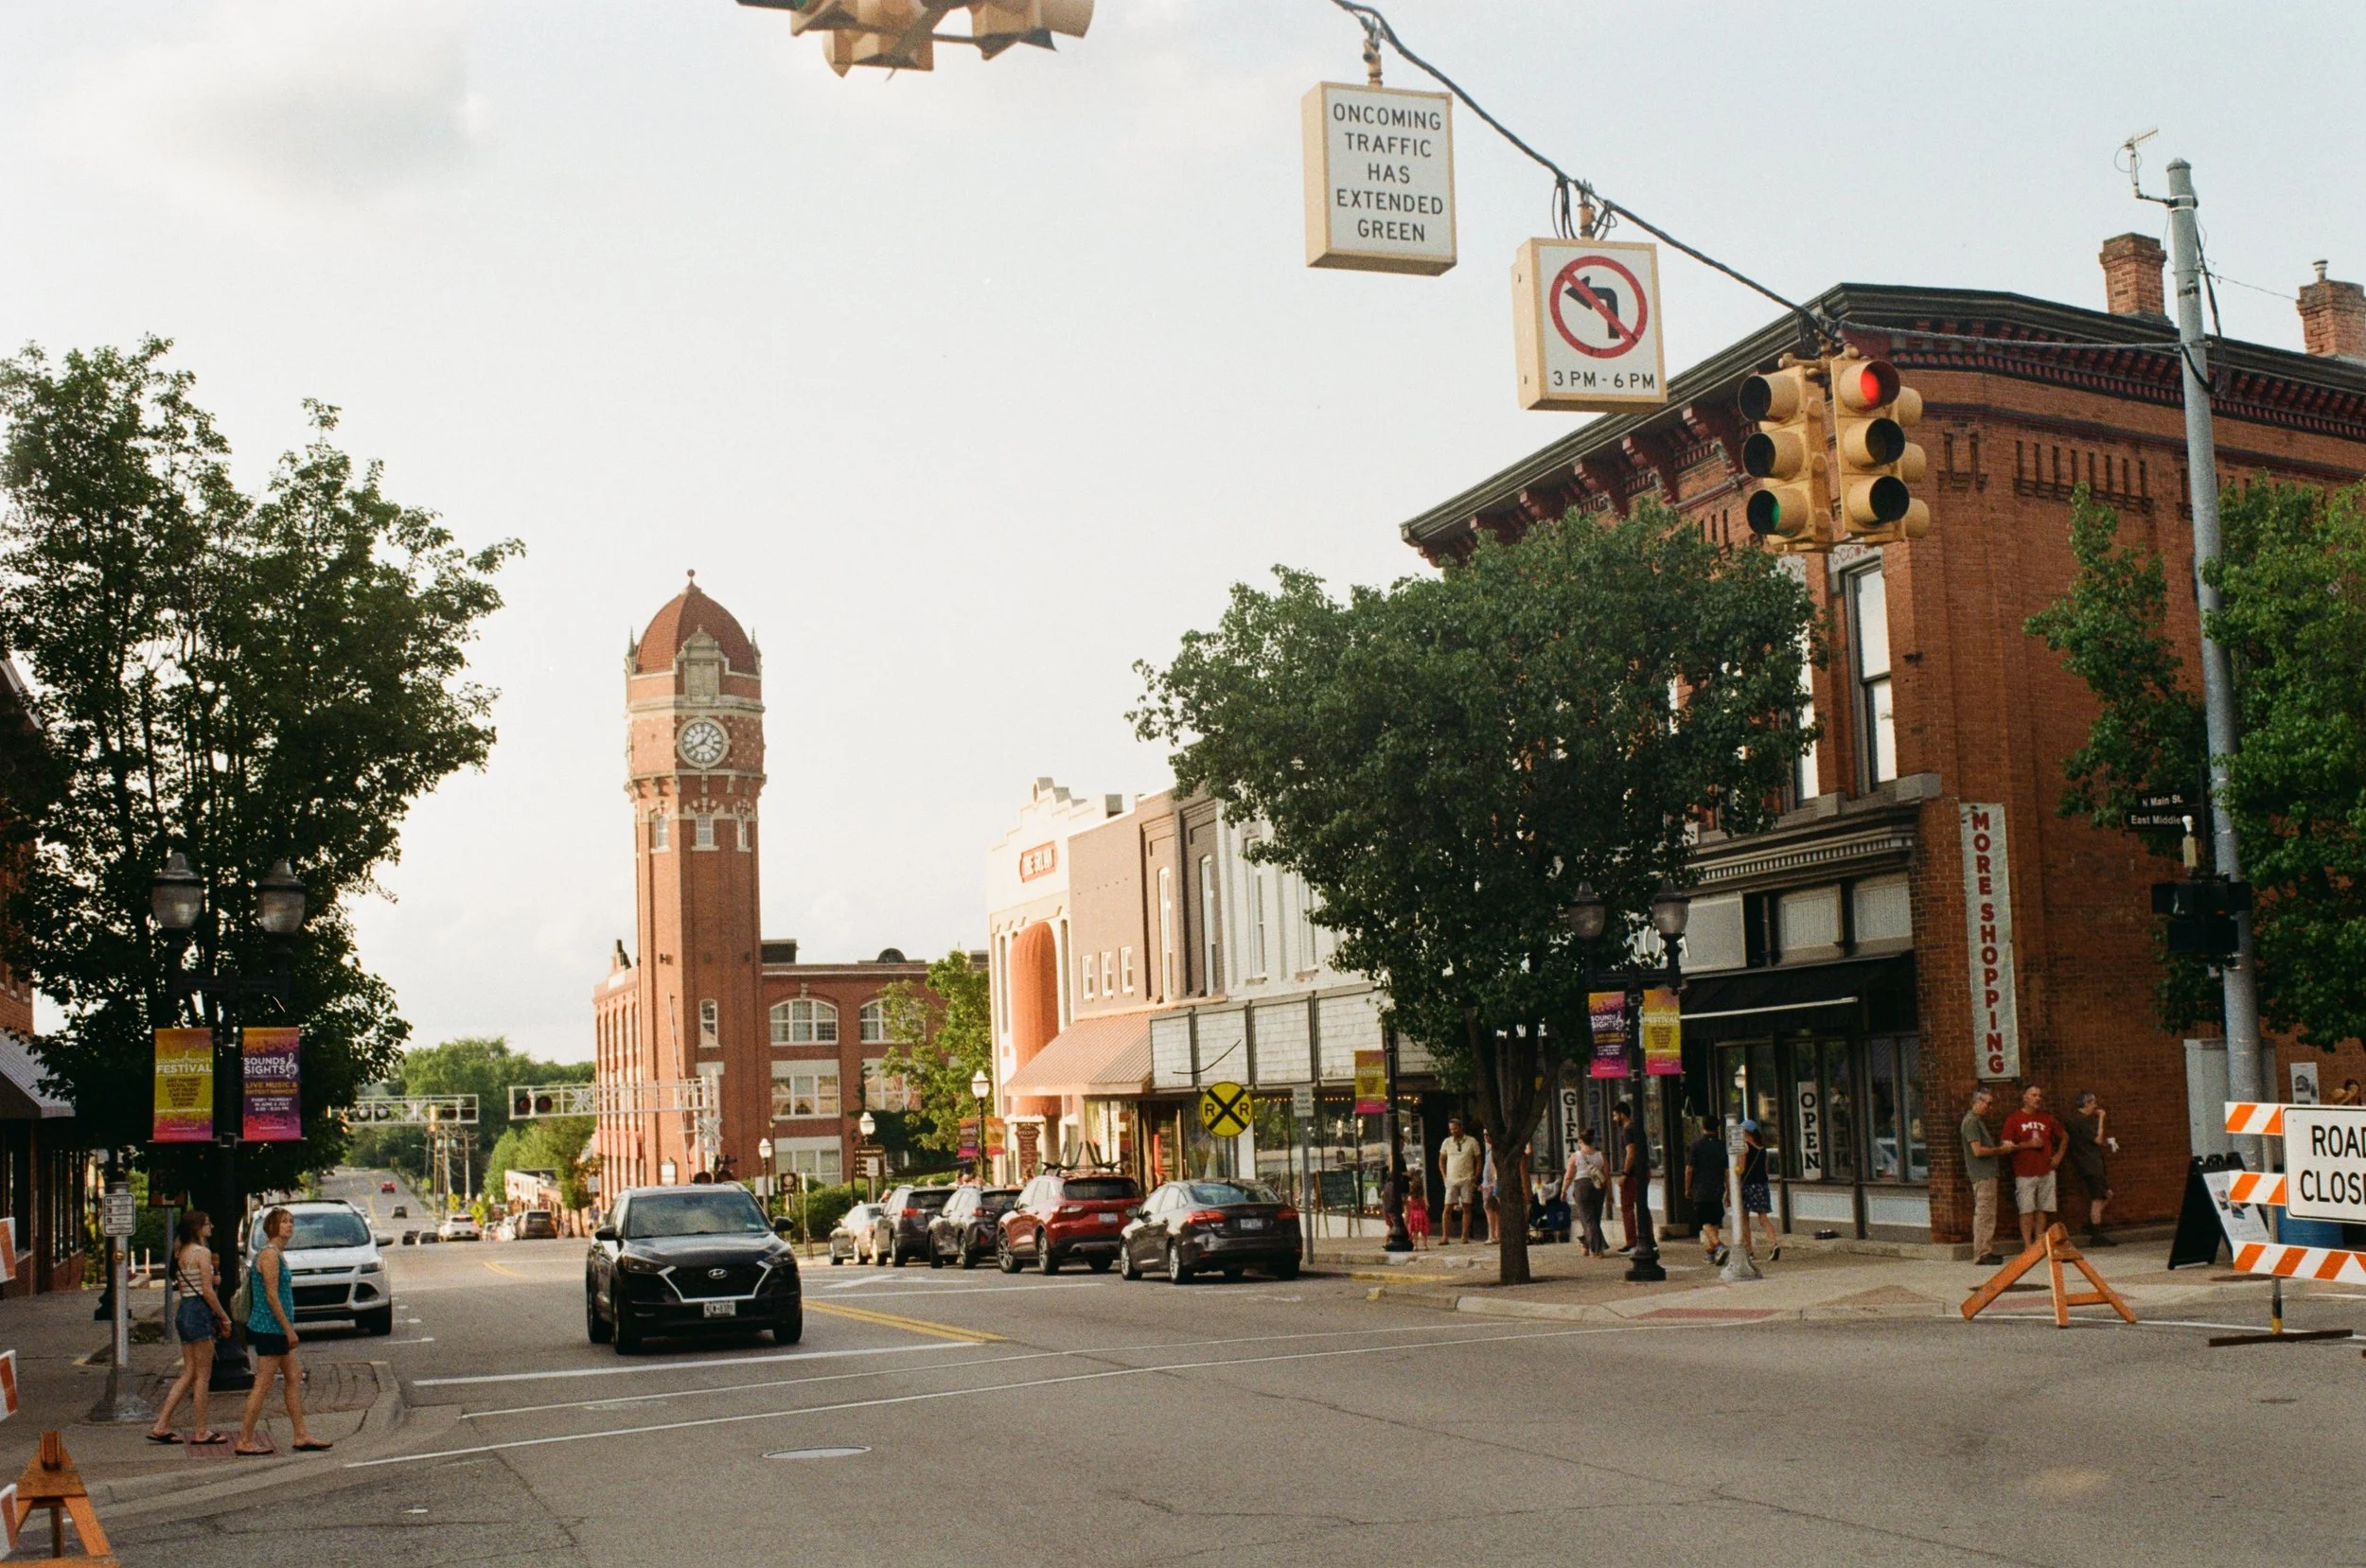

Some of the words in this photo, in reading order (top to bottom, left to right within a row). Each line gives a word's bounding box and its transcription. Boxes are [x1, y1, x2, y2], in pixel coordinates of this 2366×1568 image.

[1333, 102, 1441, 131] ONCOMING
[1344, 132, 1431, 158] TRAFFIC
[1368, 162, 1410, 184] HAS
[1336, 188, 1443, 215] EXTENDED
[1357, 219, 1425, 242] GREEN
[1553, 370, 1563, 387] 3
[1570, 370, 1597, 387] PM
[1614, 372, 1624, 389] 6
[1629, 372, 1654, 389] PM
[2142, 798, 2148, 807] N
[2150, 796, 2170, 806] Main
[2130, 815, 2150, 825] East
[2152, 815, 2181, 825] Middle
[1971, 811, 1992, 896] MORE
[1980, 902, 2004, 1074] SHOPPING
[1591, 1013, 1616, 1022] SOUNDS
[1591, 1020, 1616, 1029] SIGHTS
[1643, 1014, 1680, 1023] FESTIVAL
[156, 1063, 213, 1073] FESTIVAL
[243, 1057, 286, 1066] SOUNDS
[244, 1066, 286, 1074] SIGHTS
[1205, 1103, 1215, 1117] R
[1239, 1102, 1249, 1116] R
[1563, 1092, 1578, 1158] GIFT
[1800, 1092, 1820, 1170] OPEN
[2021, 1121, 2046, 1131] MIT
[2300, 1169, 2366, 1206] CLOS
